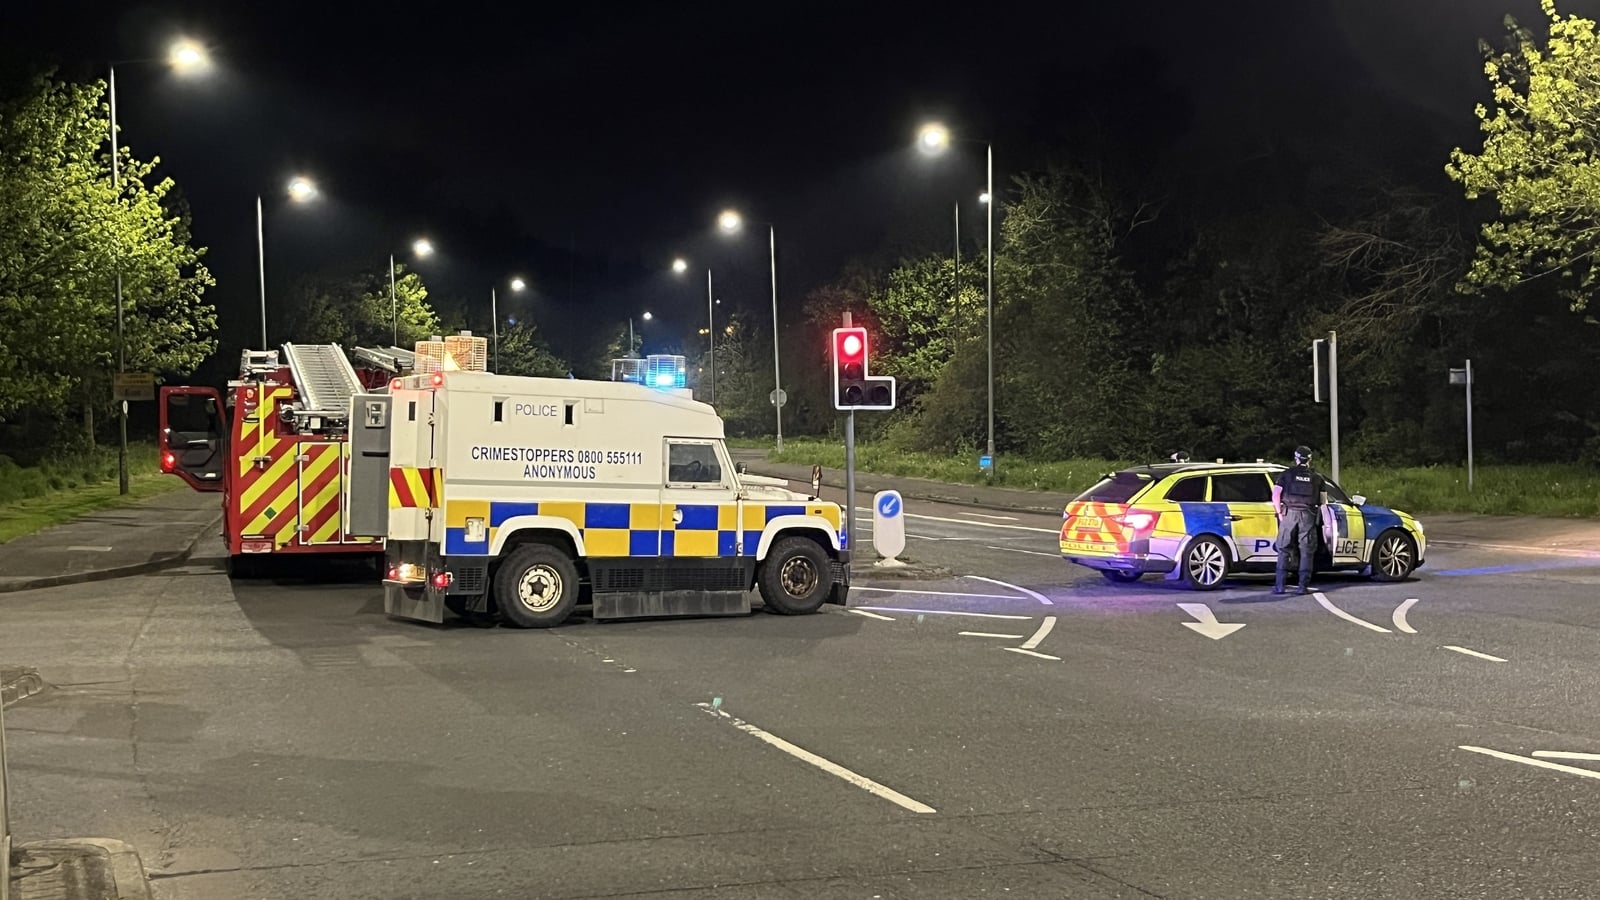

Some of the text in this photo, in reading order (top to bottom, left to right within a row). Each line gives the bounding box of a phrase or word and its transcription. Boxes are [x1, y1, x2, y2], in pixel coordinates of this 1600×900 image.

[516, 404, 557, 417] POLICE
[472, 447, 642, 465] CRIMESTOPPERS 0800 555111
[524, 465, 595, 479] ANONYMOUS
